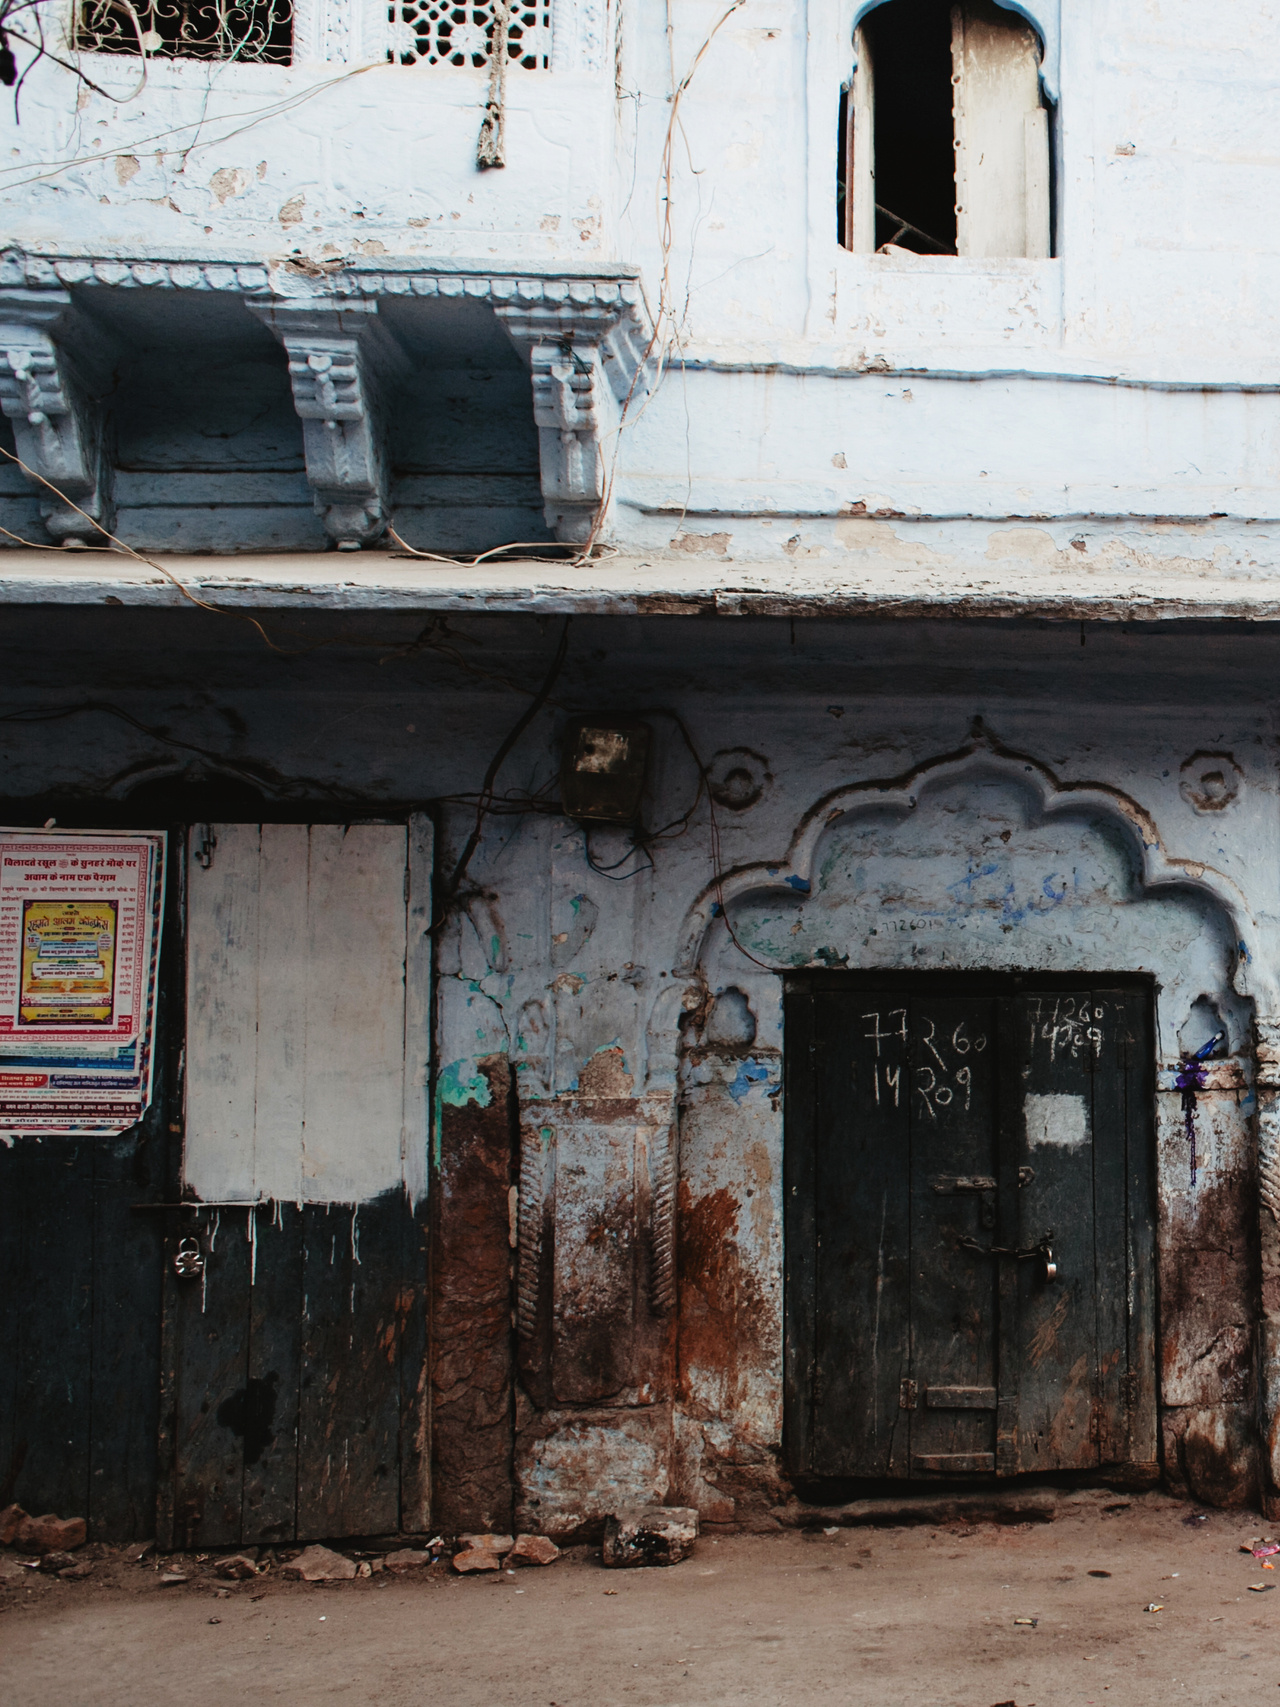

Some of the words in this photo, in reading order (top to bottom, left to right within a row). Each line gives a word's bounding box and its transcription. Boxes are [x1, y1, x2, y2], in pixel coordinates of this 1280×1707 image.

[4, 858, 35, 867] विलादते
[37, 858, 57, 869] रसूल
[70, 858, 79, 867] के
[81, 858, 104, 869] सुनहरे
[126, 859, 137, 867] पर
[24, 873, 48, 881] अवाम
[50, 872, 58, 881] के
